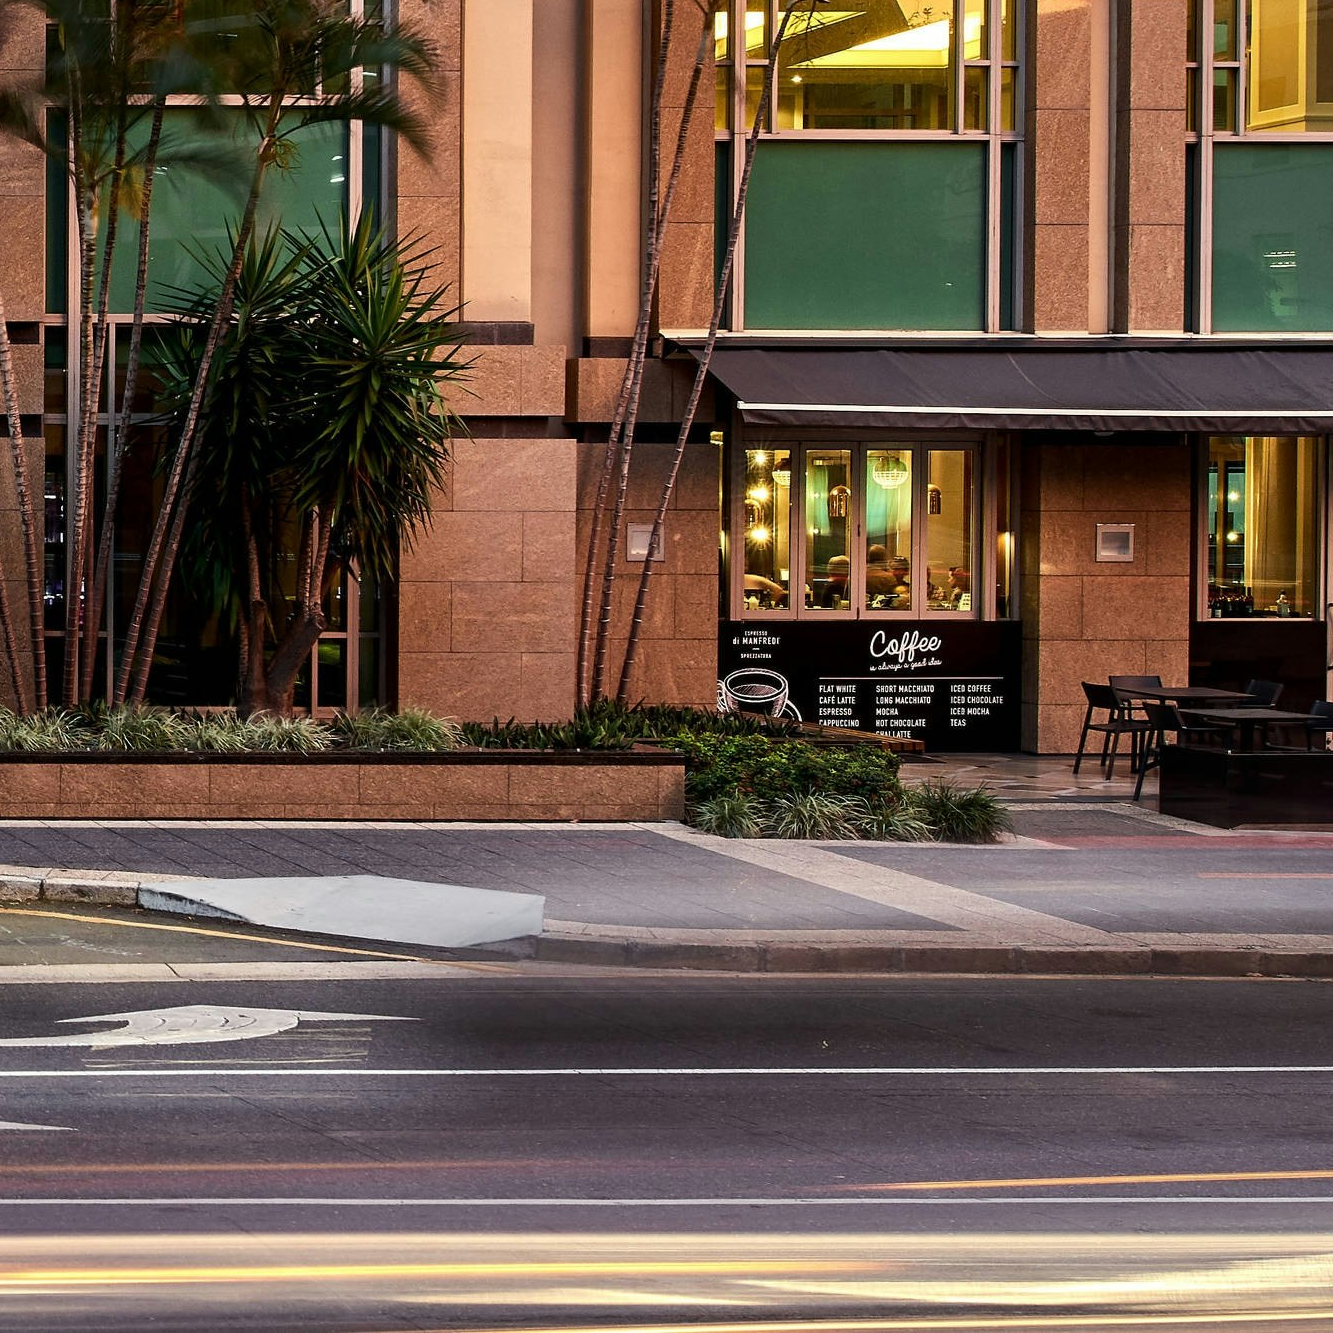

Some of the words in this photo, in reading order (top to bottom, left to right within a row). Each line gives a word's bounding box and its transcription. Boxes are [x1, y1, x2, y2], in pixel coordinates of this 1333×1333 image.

[869, 630, 942, 663] Coffee
[878, 661, 902, 672] always
[910, 657, 927, 670] good
[819, 685, 834, 693] FLAT
[835, 685, 857, 693] WHITE
[875, 685, 897, 693] SHORT
[898, 685, 935, 693] MACCHIATO
[950, 685, 966, 693] ICED
[967, 685, 992, 693] COFFEE
[819, 695, 835, 704] CAFÉ
[837, 696, 856, 704] LATTE
[875, 696, 894, 704] LONG
[894, 696, 931, 704] MACCHIATO
[950, 696, 966, 704] ICED
[967, 696, 1004, 704] CHOCOLATE
[819, 707, 853, 716] ESPRESSO
[875, 707, 899, 716] MOCHA
[950, 707, 966, 715] ICED
[967, 707, 990, 715] MOCHA
[818, 719, 860, 727] CAPPUCCINO
[875, 719, 888, 727] HOT
[889, 719, 926, 727] CHOCOLATE
[950, 718, 967, 727] TEAS
[892, 730, 912, 738] LATTE
